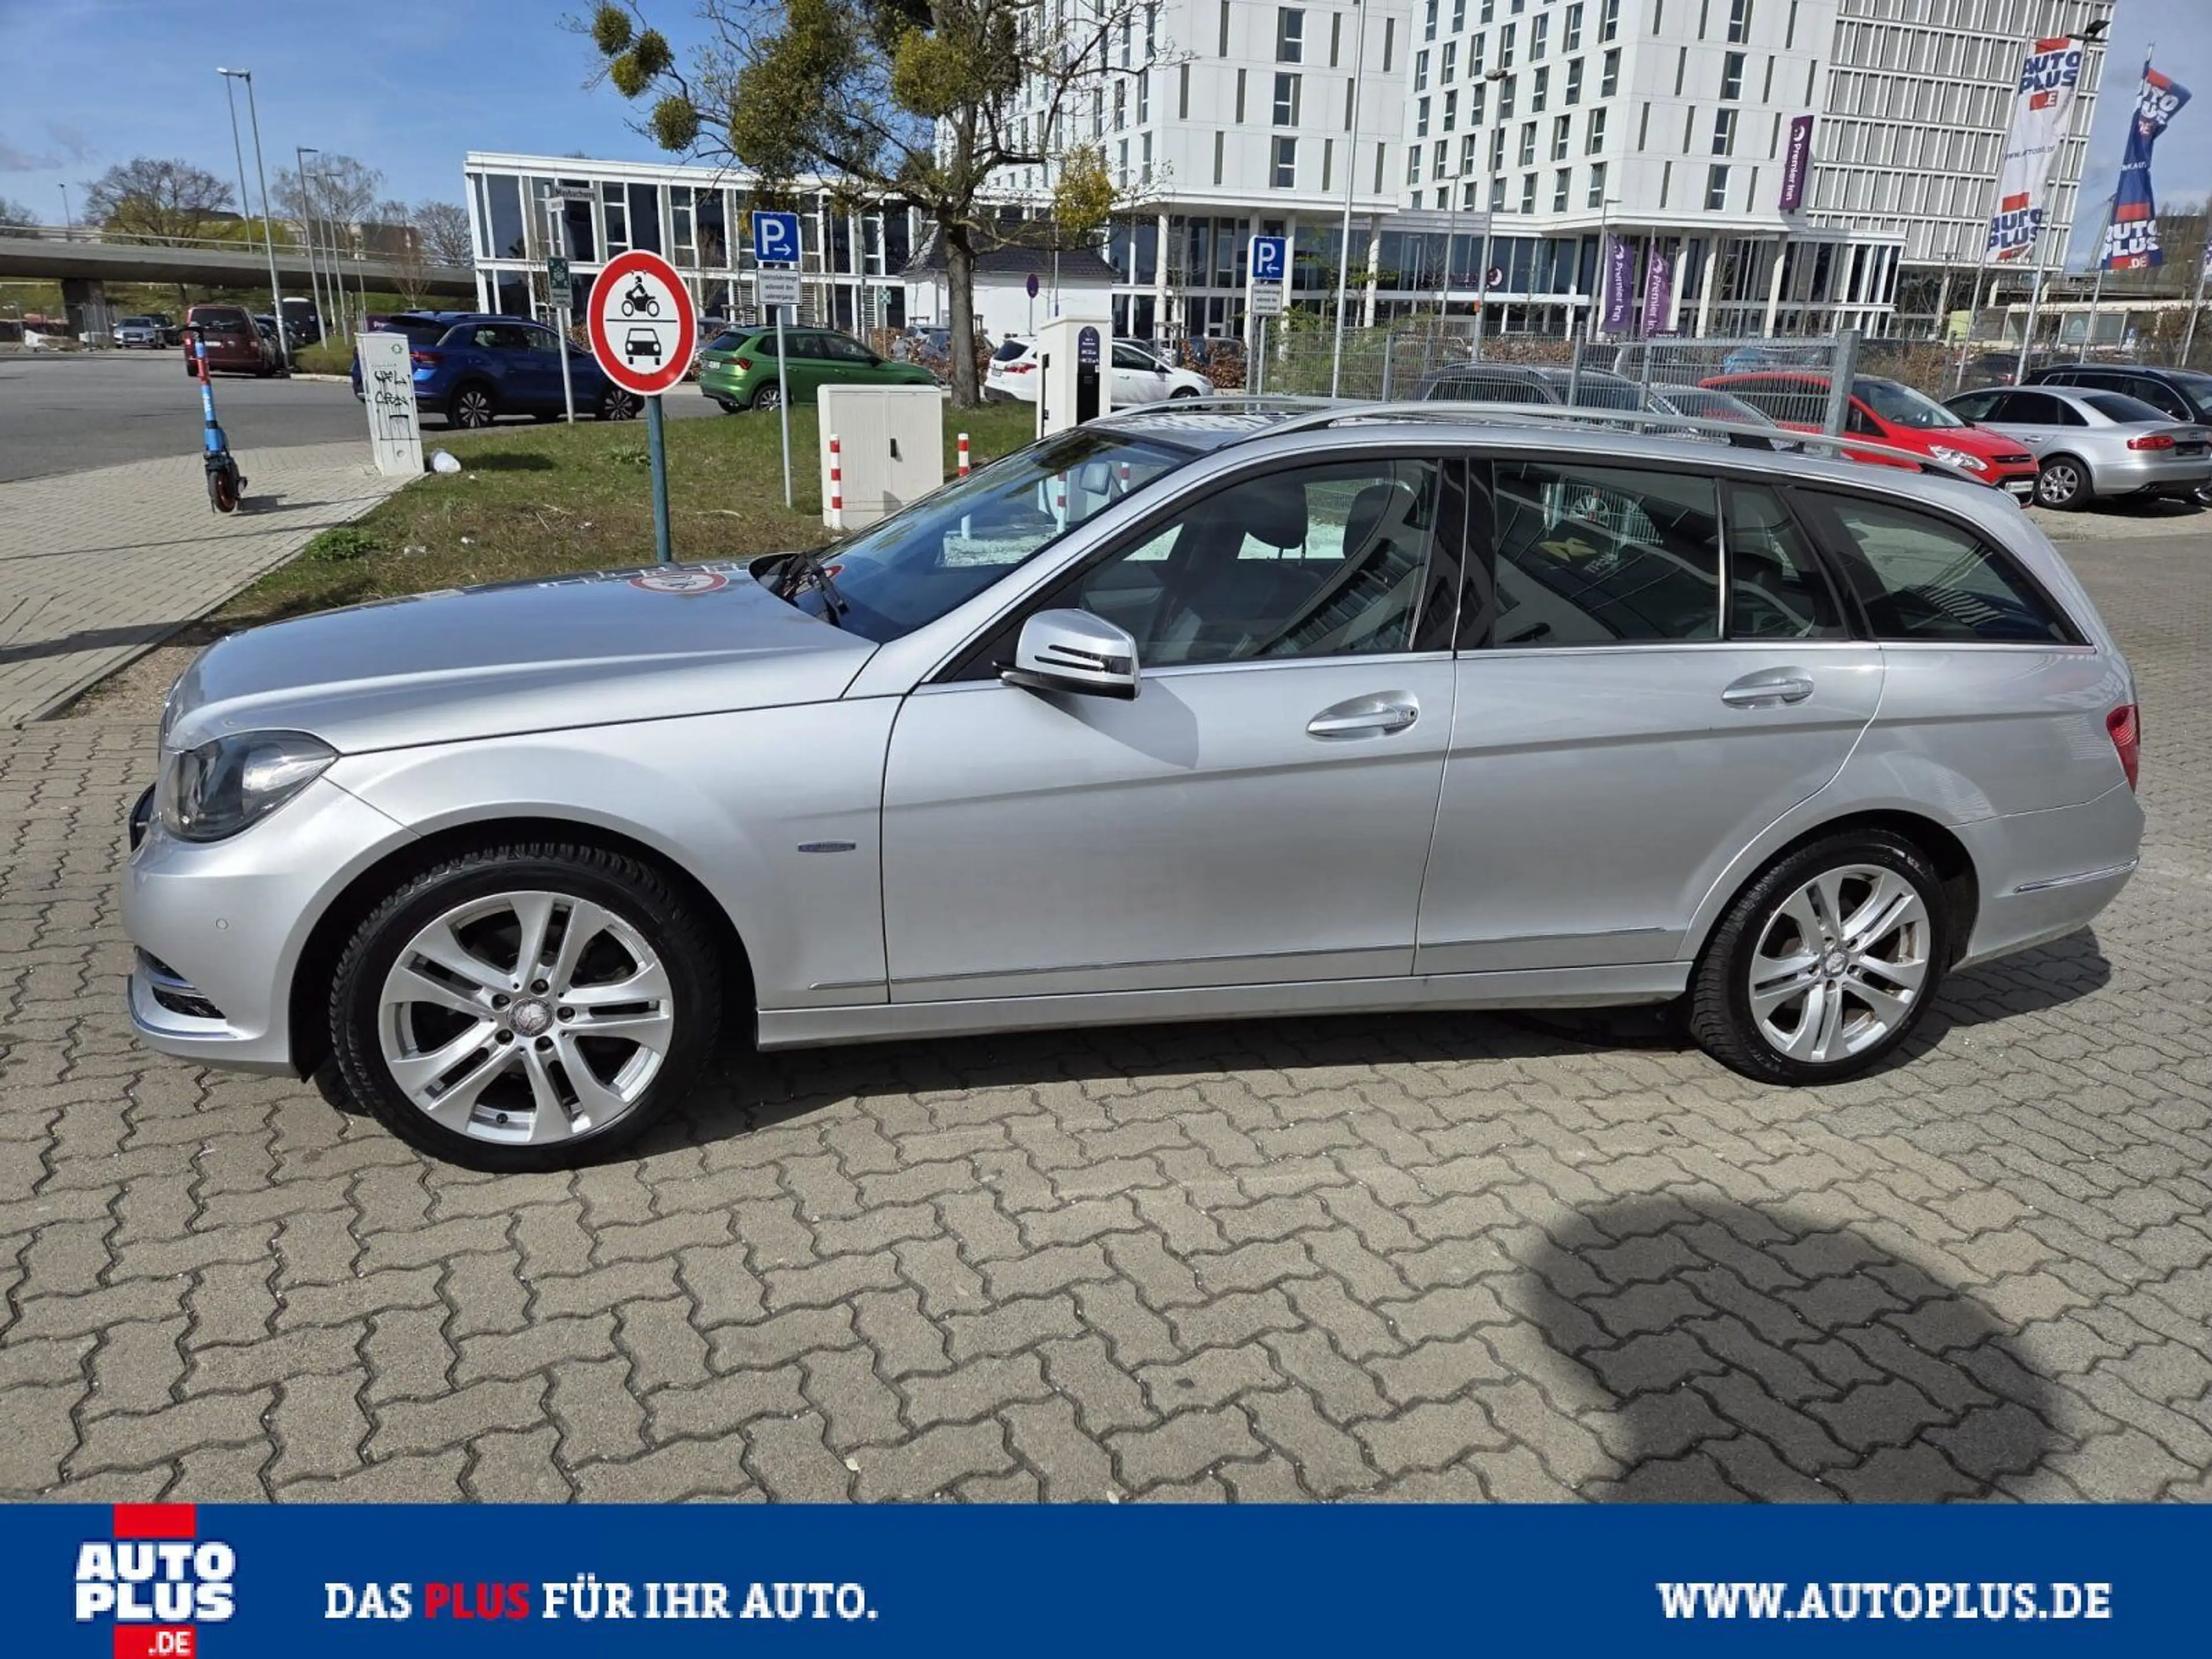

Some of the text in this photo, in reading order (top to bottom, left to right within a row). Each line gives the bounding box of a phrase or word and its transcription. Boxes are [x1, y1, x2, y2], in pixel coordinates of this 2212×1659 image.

[2022, 51, 2082, 76] AUTO
[2018, 69, 2078, 94] PLUS
[1785, 143, 1802, 201] Premier Inn
[760, 218, 785, 255] P
[1257, 242, 1276, 273] P
